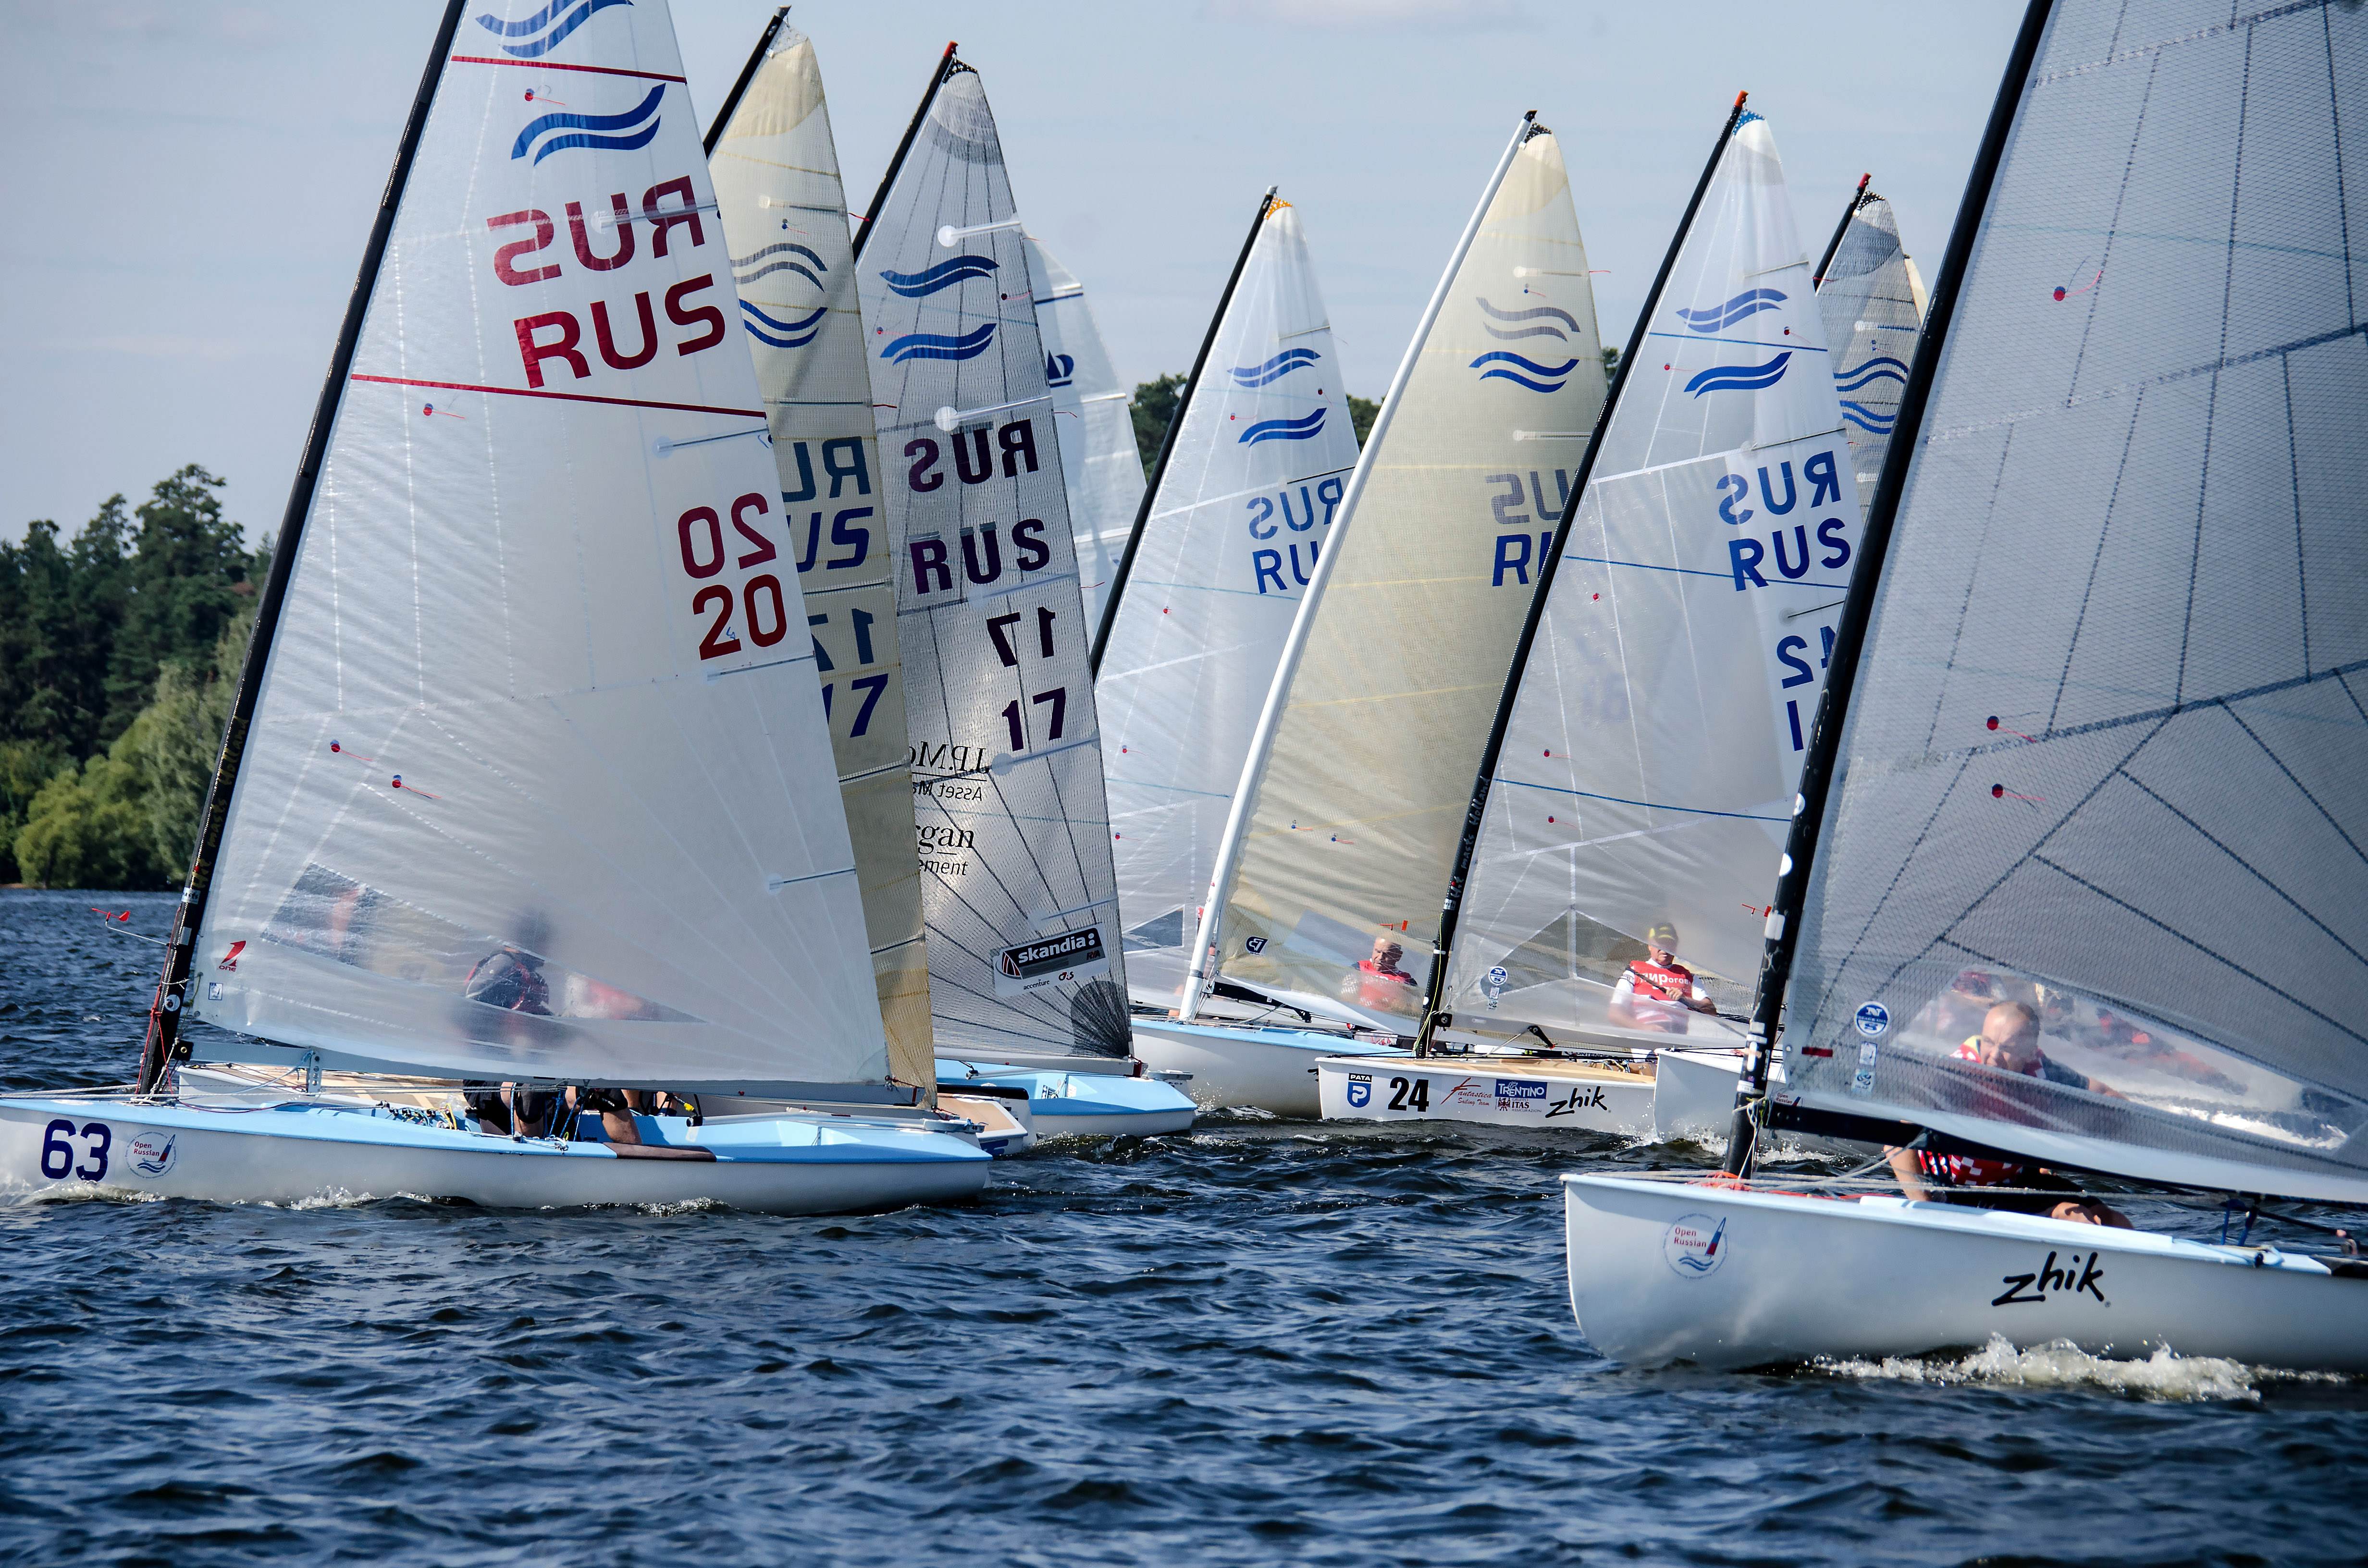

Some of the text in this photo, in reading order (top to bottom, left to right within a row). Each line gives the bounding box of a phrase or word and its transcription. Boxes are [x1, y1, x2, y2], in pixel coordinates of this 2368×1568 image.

[514, 273, 725, 388] RUS
[908, 518, 1050, 594] RUS
[1728, 517, 1850, 591] RUS
[693, 575, 787, 660] 20
[1002, 687, 1066, 751] 17
[916, 825, 974, 854] gan
[1023, 979, 1050, 990] accenture
[1388, 1077, 1429, 1112] 24
[1441, 1077, 1492, 1105] Fantastica
[1457, 1097, 1475, 1106] Sailing
[1498, 1083, 1544, 1097] TRENTINO
[1545, 1086, 1608, 1118] zhik
[41, 1119, 111, 1182] 63
[134, 1148, 160, 1157] Russian
[1674, 1236, 1707, 1248] Russian
[1675, 1226, 1697, 1237] Open
[1991, 1251, 2105, 1307] zhik
